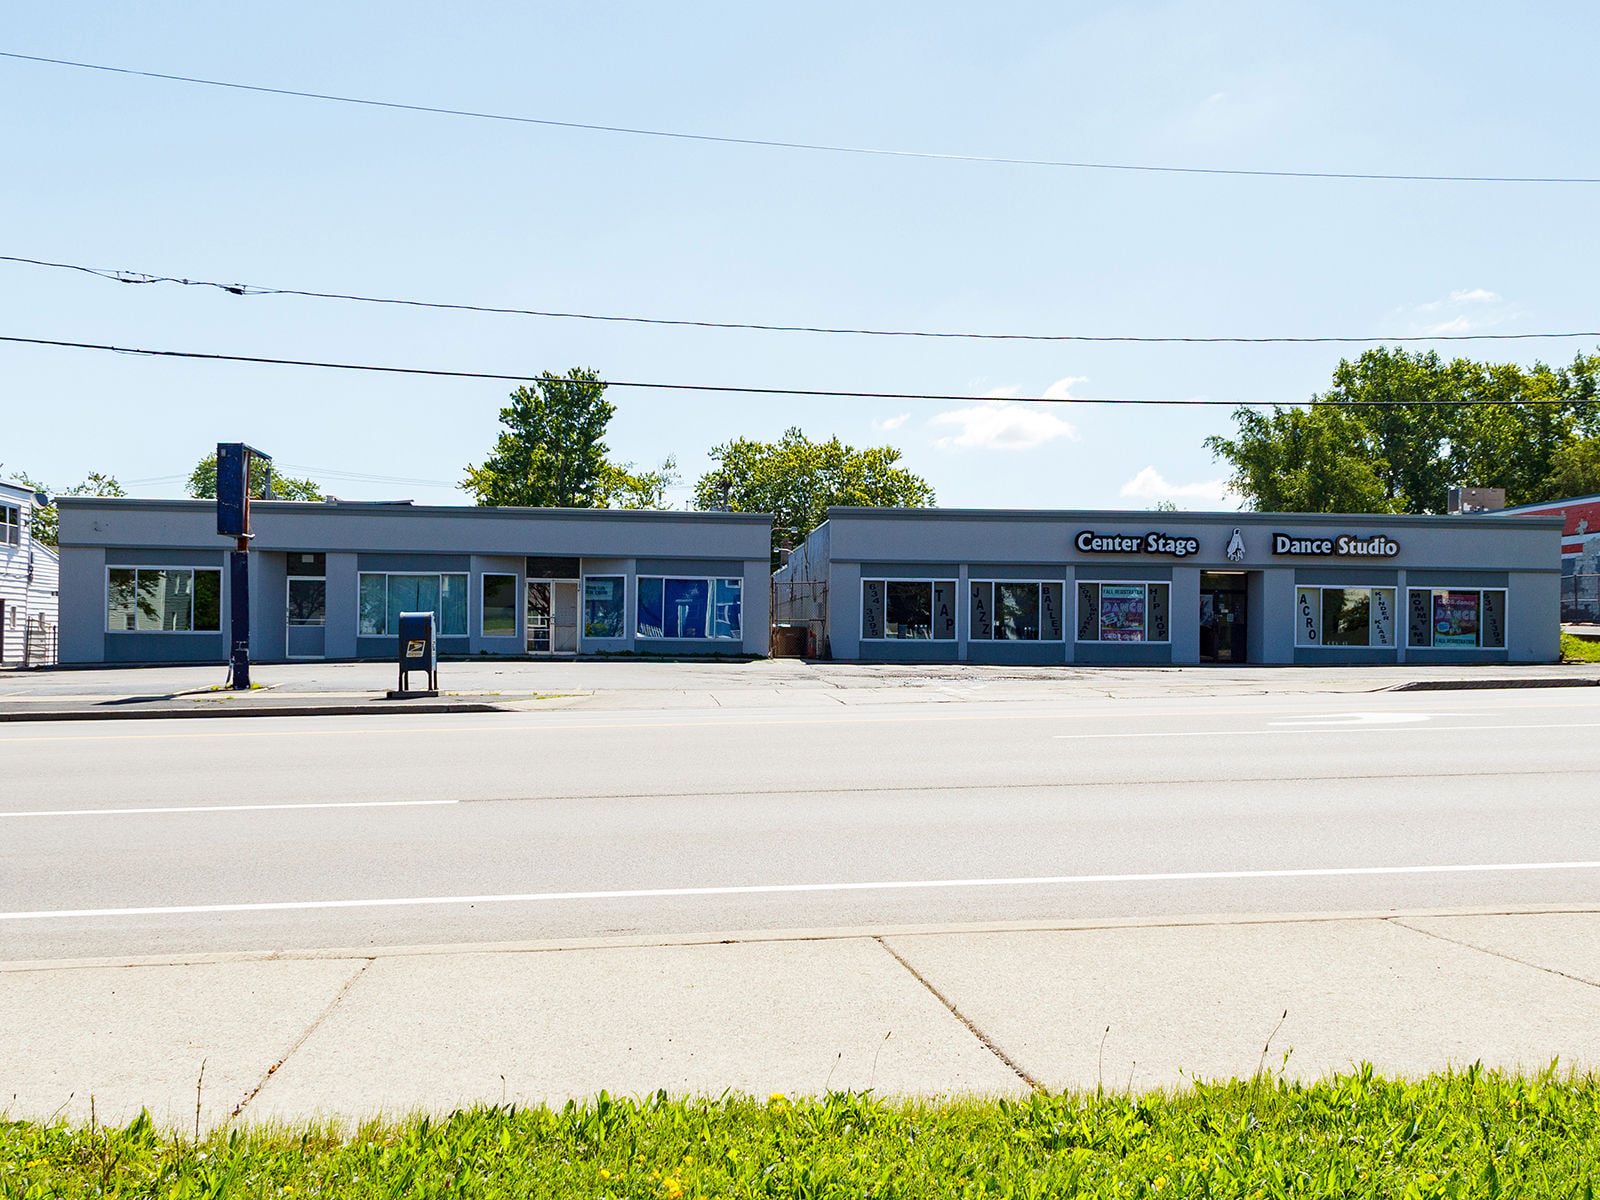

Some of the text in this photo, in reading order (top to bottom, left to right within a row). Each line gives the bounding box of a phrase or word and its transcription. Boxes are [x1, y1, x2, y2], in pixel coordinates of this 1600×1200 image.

[1077, 532, 1197, 555] Center Stage
[1276, 535, 1398, 555] Dance Studio
[935, 589, 954, 631] TAP
[973, 587, 989, 635] JAZZ
[1042, 586, 1060, 636] BALLET
[1103, 602, 1143, 613] DANCE
[1149, 588, 1166, 637] HIP HOP
[1299, 593, 1317, 640] ACRO
[1374, 591, 1390, 645] KINDER KLASS
[1410, 592, 1428, 625] MOMMY
[1436, 608, 1477, 620] DANCE
